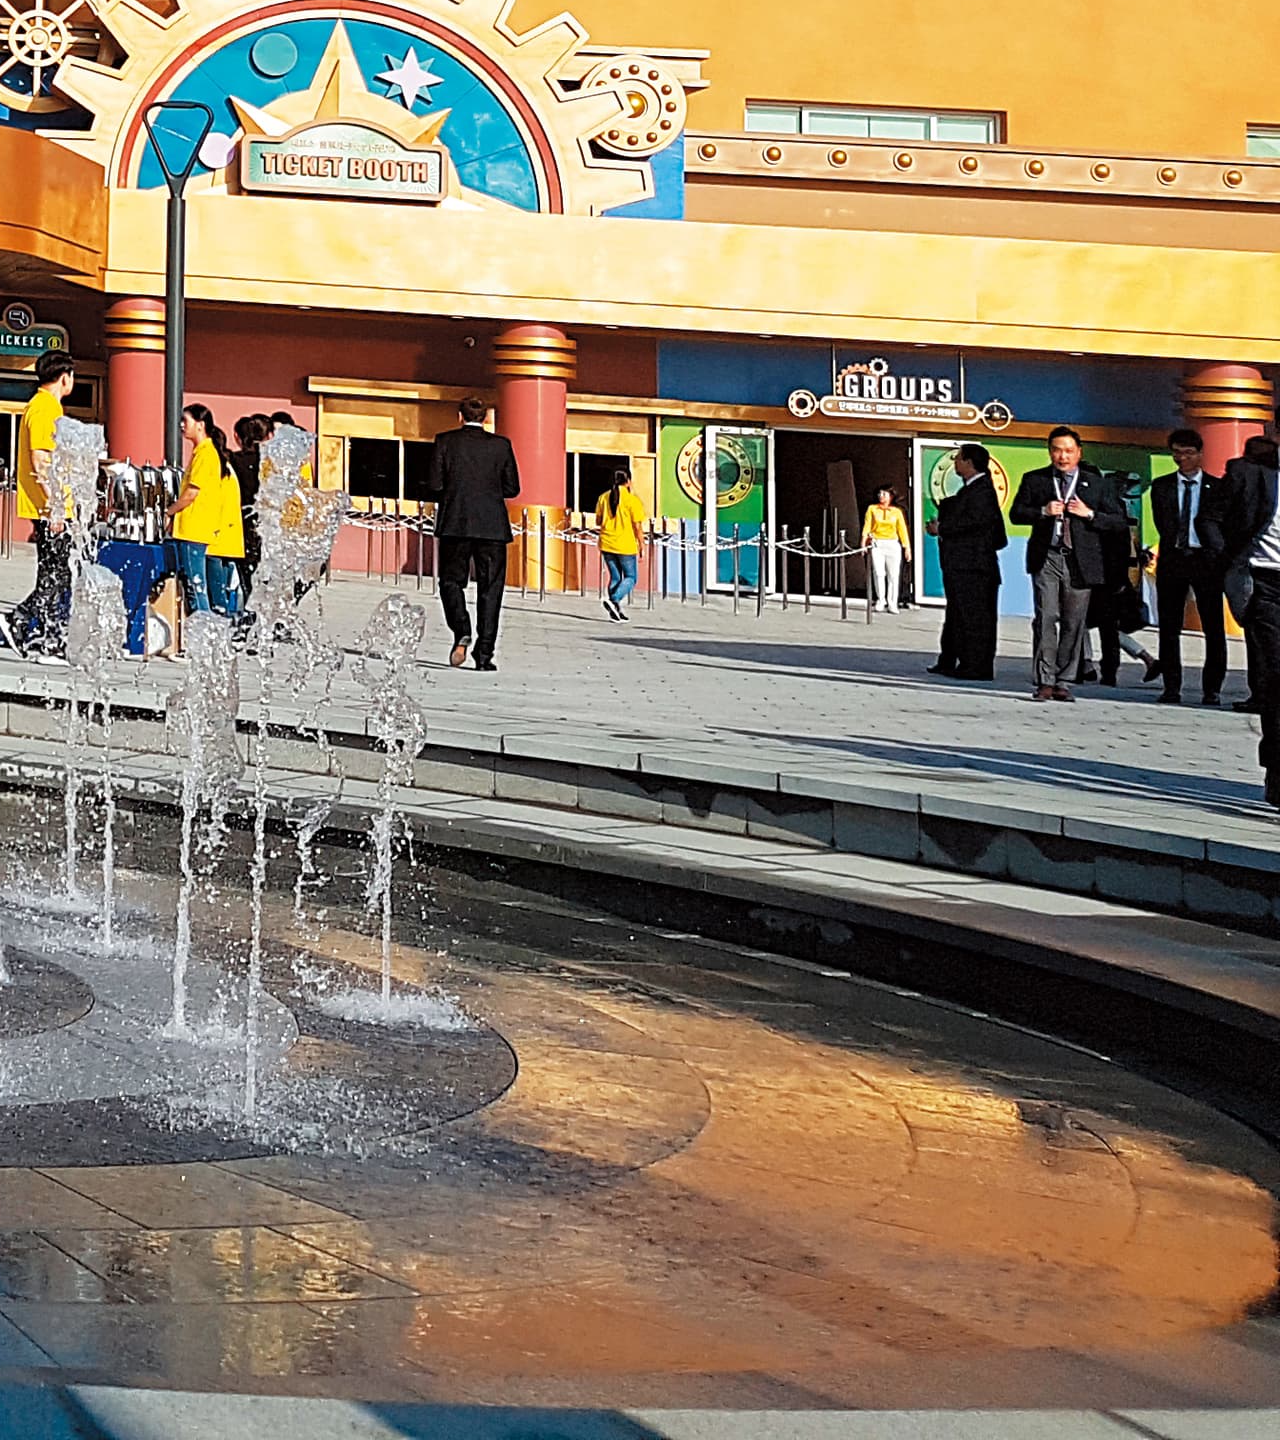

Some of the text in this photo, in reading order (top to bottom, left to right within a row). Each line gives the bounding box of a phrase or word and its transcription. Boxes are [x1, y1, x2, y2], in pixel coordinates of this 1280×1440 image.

[261, 152, 429, 184] TICKET BOOTH
[843, 374, 953, 403] GROUPS
